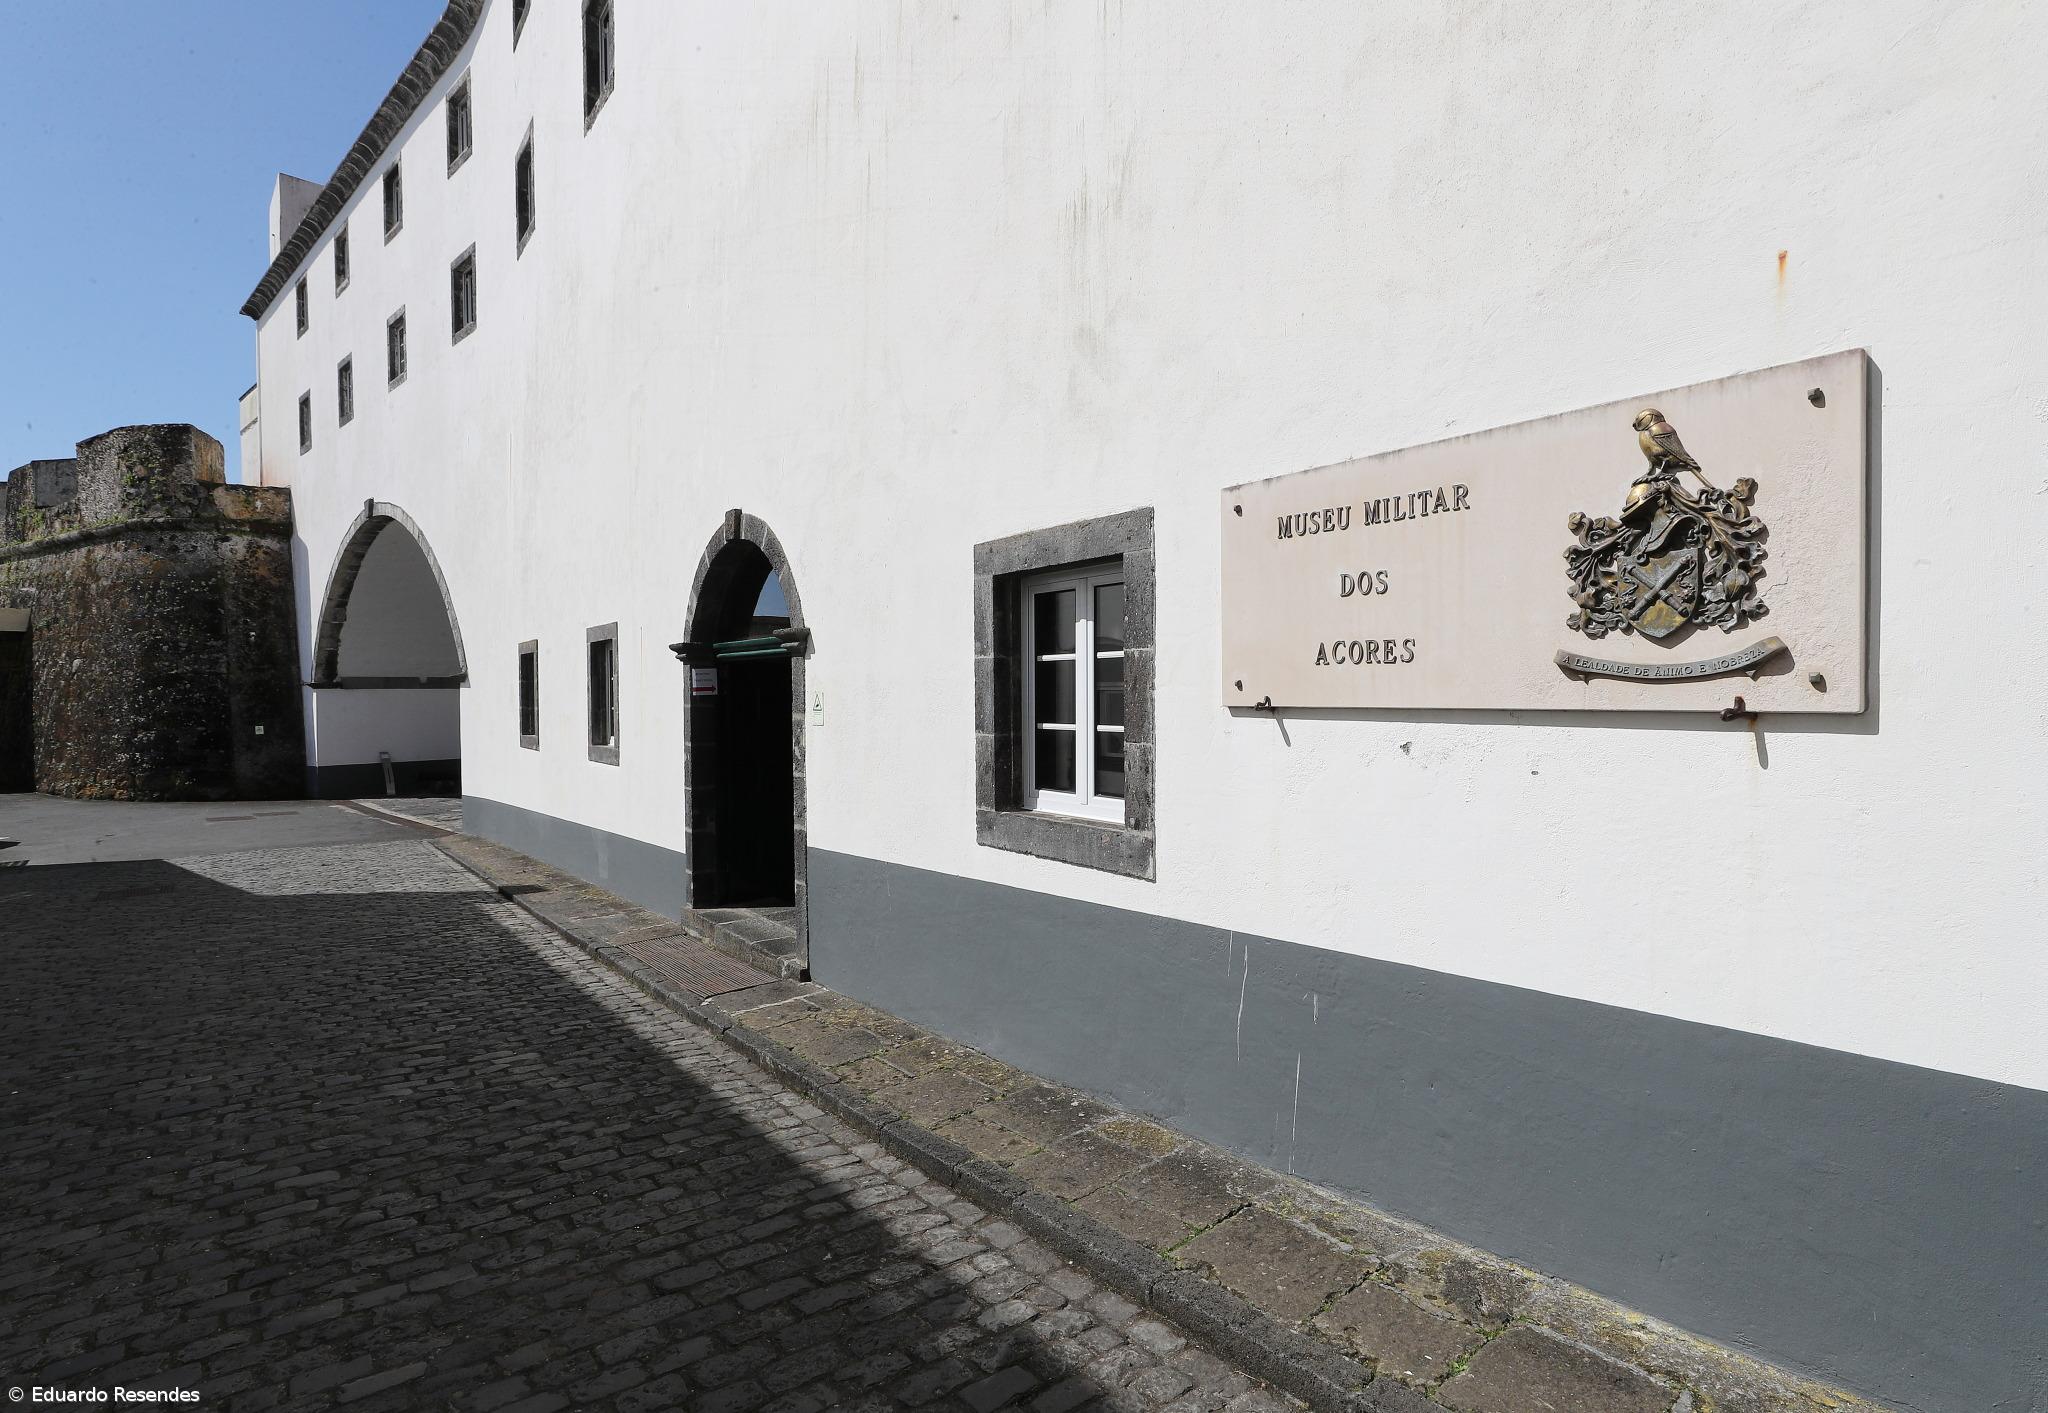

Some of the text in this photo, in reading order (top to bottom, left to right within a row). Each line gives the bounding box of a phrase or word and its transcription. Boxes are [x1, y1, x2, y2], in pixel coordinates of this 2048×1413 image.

[1278, 484, 1470, 539] MUSEU MILITAR
[1340, 570, 1389, 597] DOS
[1562, 655, 1570, 664] A
[1575, 658, 1630, 675] LEALDADE
[1634, 666, 1650, 677] DE
[1699, 664, 1707, 673] E
[1711, 647, 1765, 670] NOBREZA
